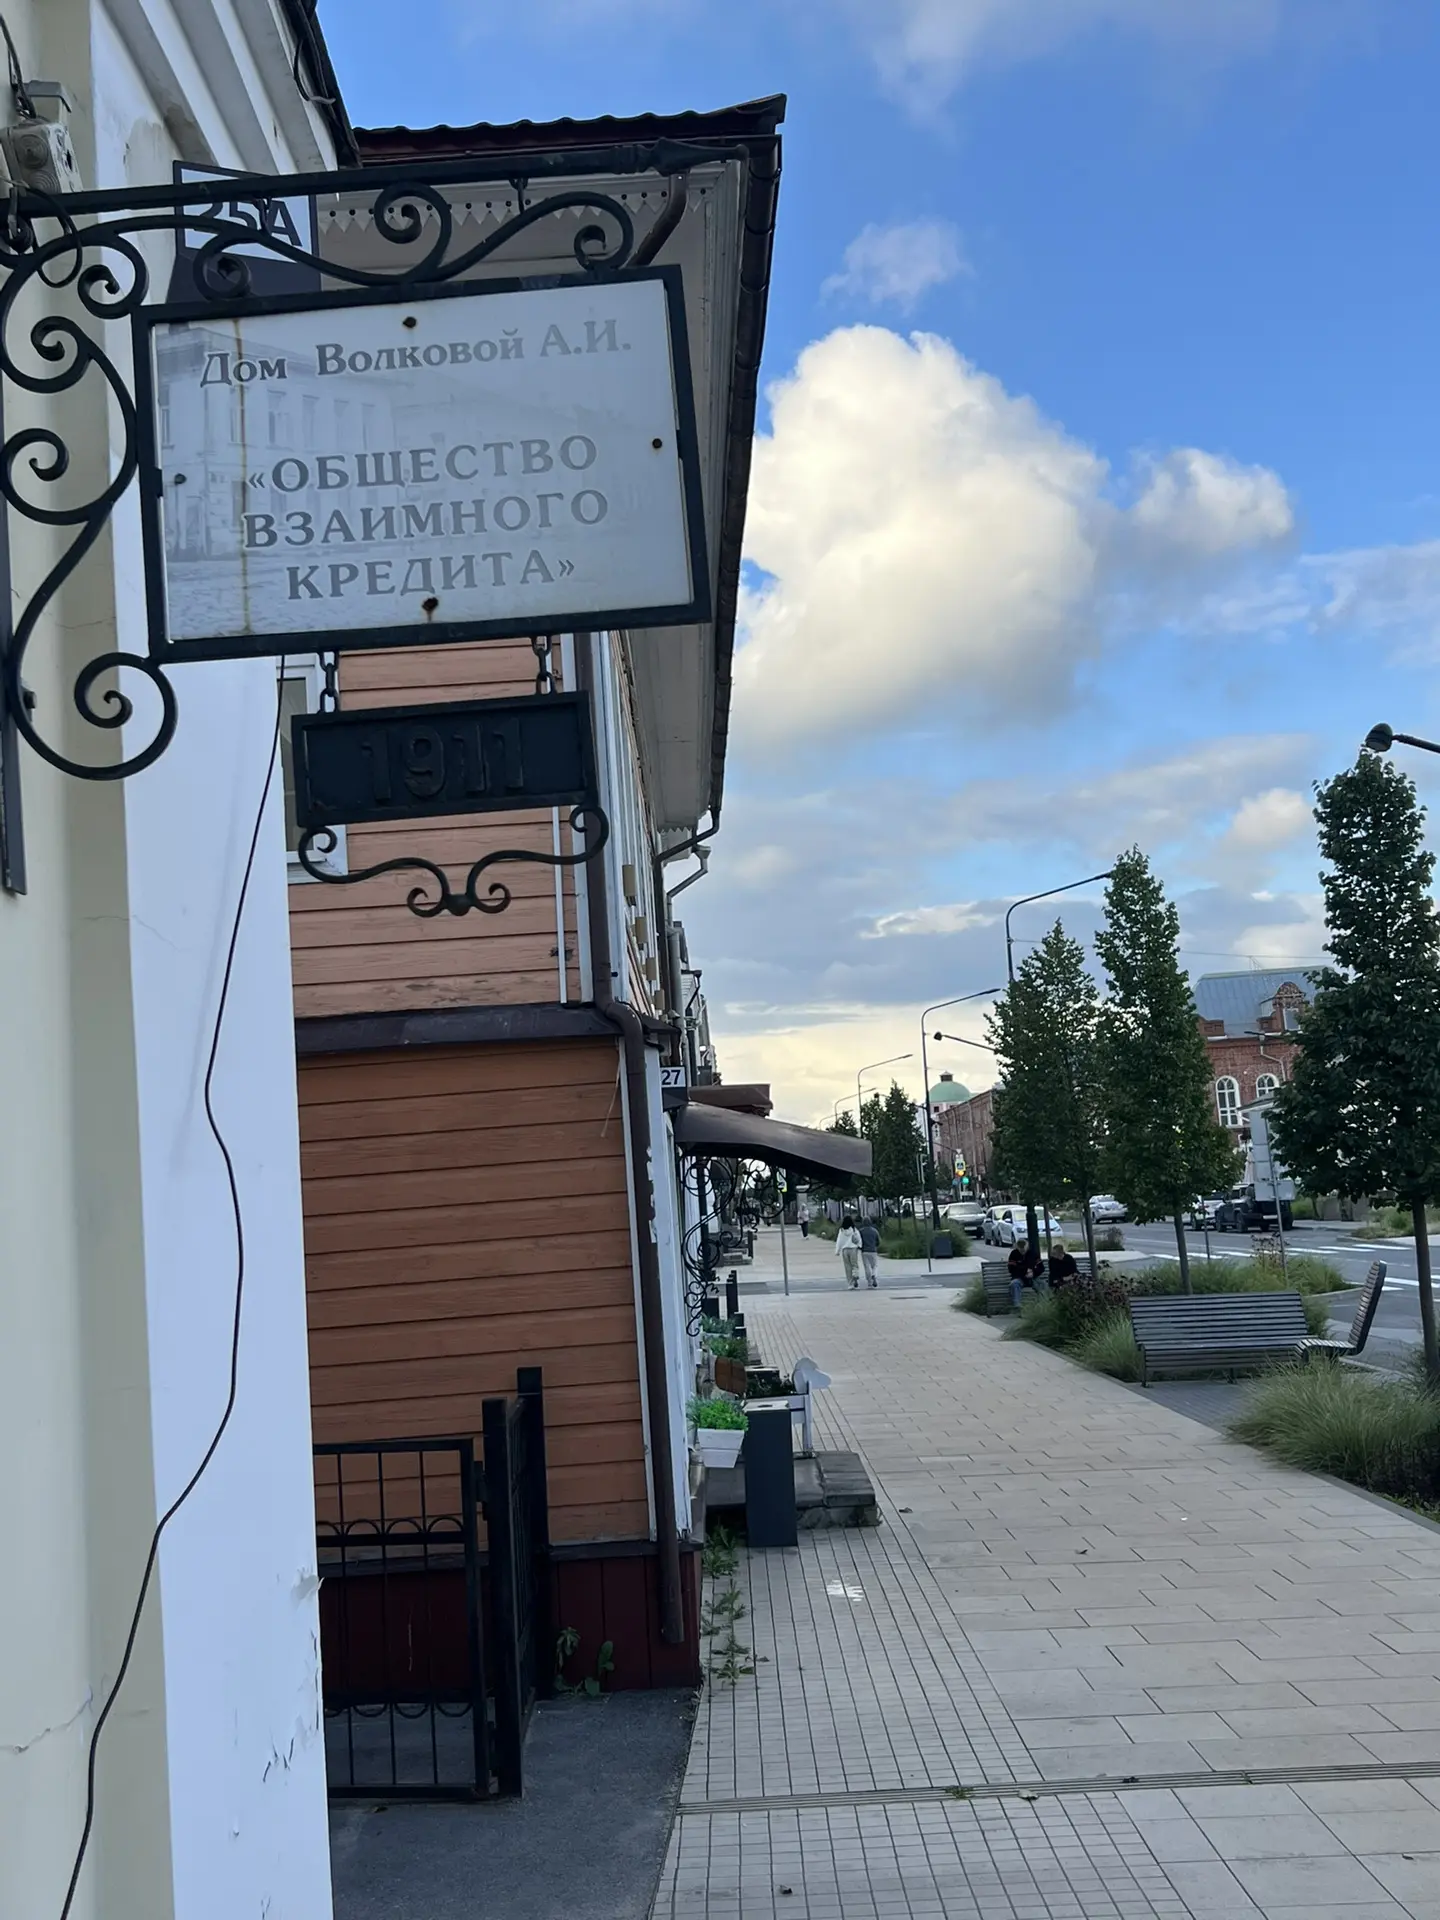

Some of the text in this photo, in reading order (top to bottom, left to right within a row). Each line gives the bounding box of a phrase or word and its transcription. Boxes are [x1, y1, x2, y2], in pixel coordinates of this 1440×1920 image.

[200, 318, 632, 387] Дом Волковой А.И.
[248, 434, 598, 493] «ОБЩЕСТВО
[243, 489, 609, 549] ВЗАИМНОГО
[287, 549, 575, 600] КРЕДИТА»
[361, 717, 524, 801] 1911
[661, 1069, 681, 1086] 27
